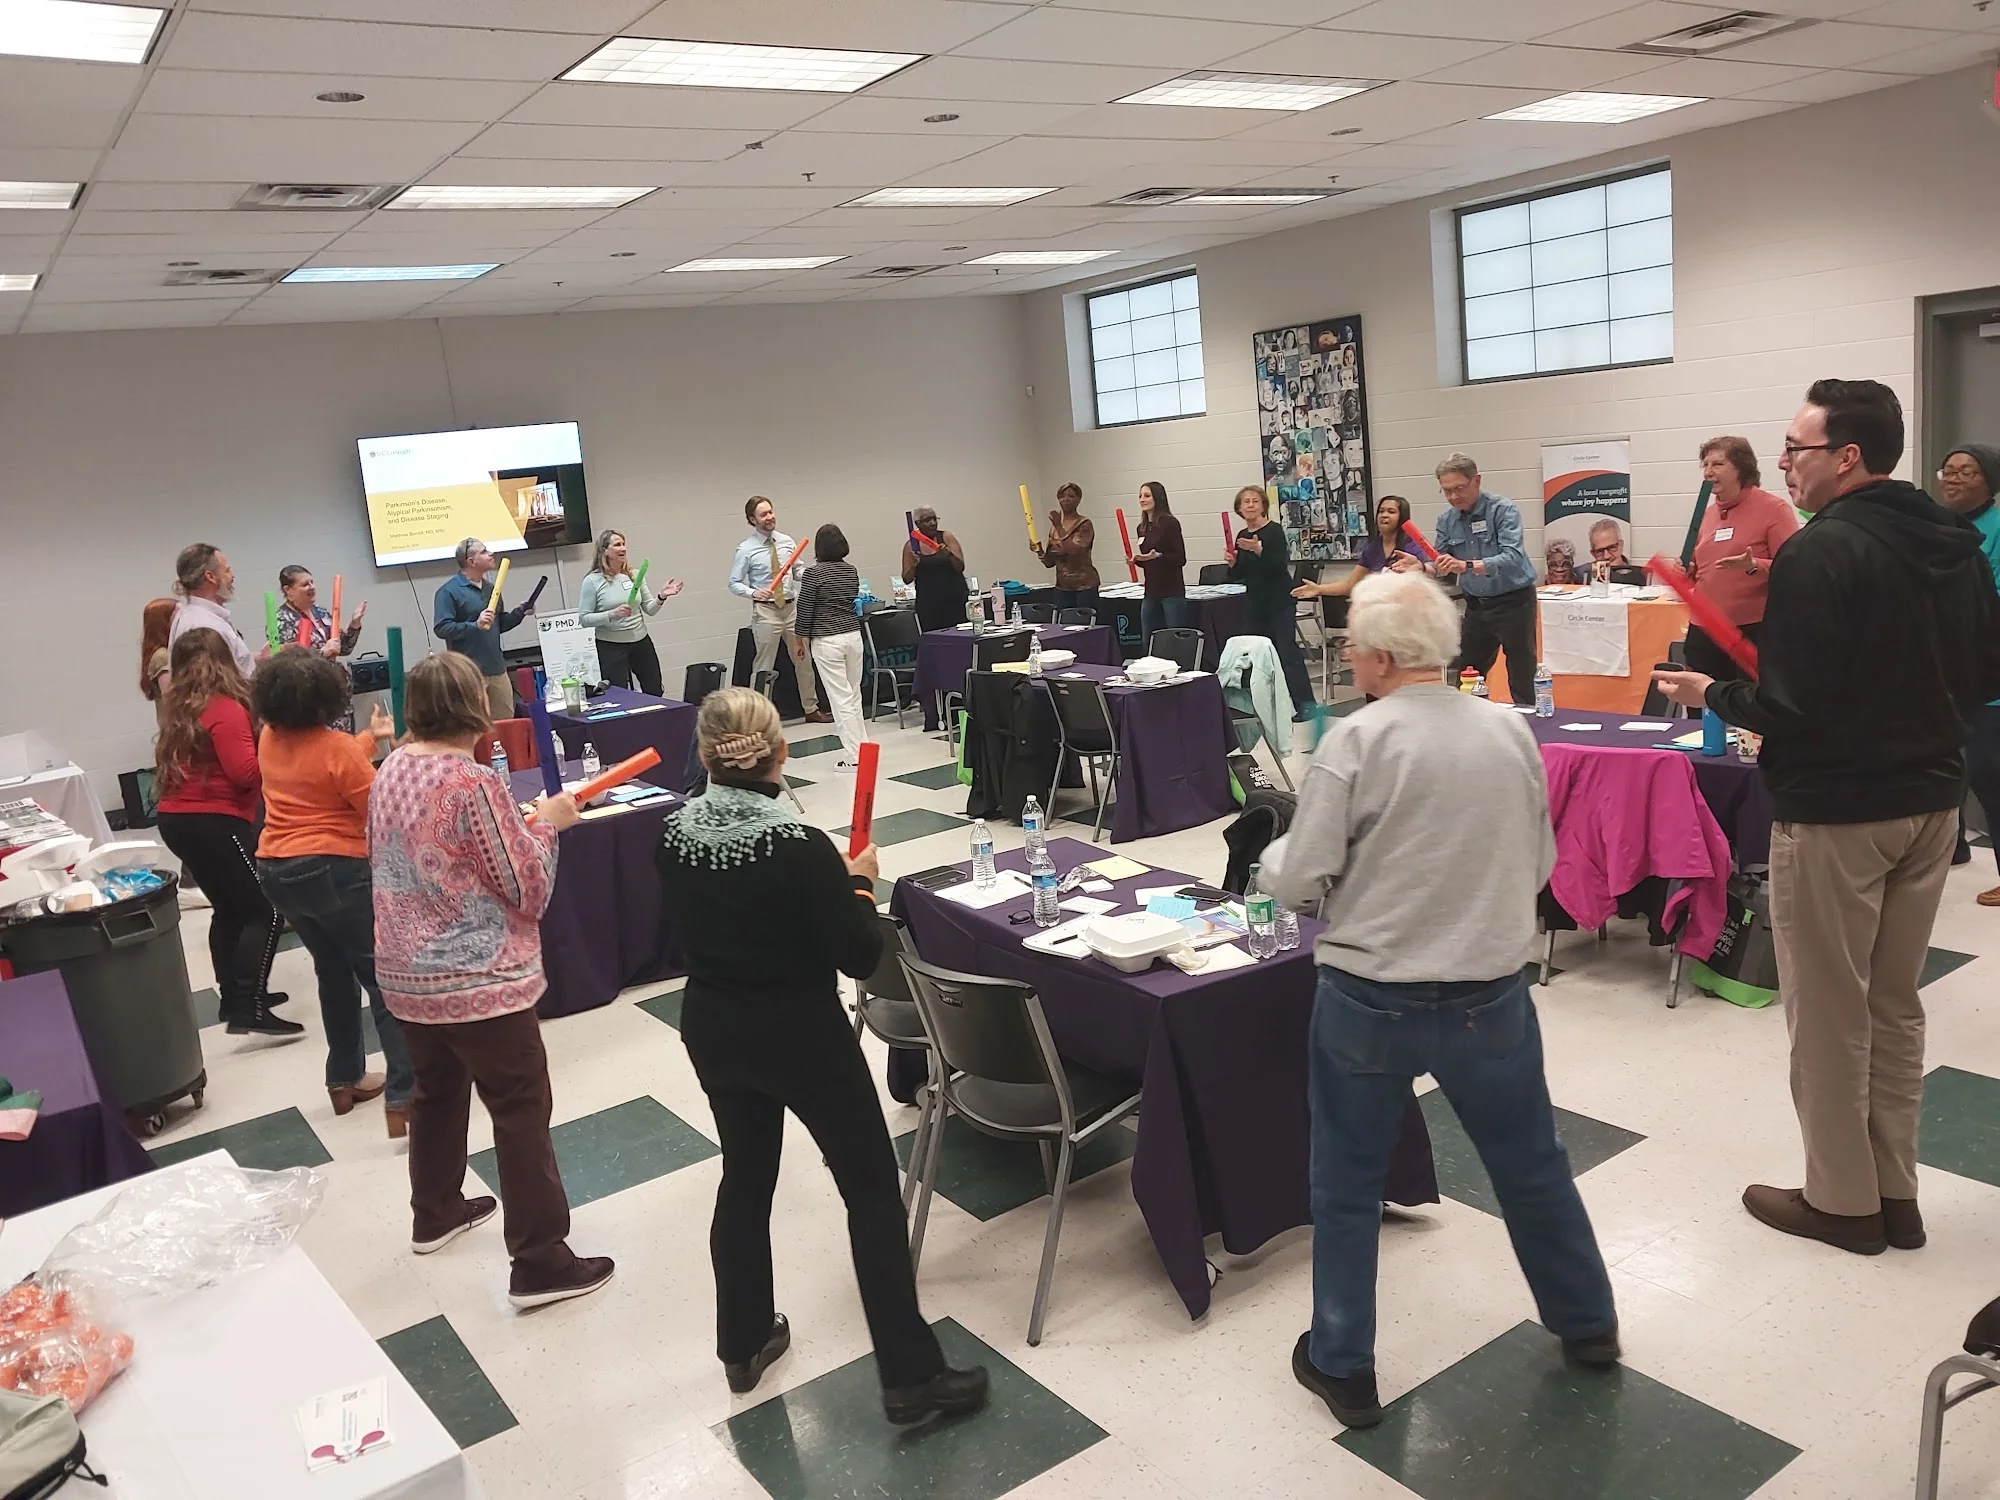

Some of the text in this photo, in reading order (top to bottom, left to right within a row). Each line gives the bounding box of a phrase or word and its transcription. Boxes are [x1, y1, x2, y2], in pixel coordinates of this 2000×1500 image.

[1577, 486, 1628, 497] A local nonprofit
[385, 497, 448, 509] Parkinson's Disease,
[1561, 497, 1628, 507] where joy happens
[386, 507, 411, 517] Atypical
[400, 514, 425, 523] Disease
[426, 512, 449, 521] Staging
[555, 618, 575, 628] PMD
[1567, 614, 1584, 622] Circle
